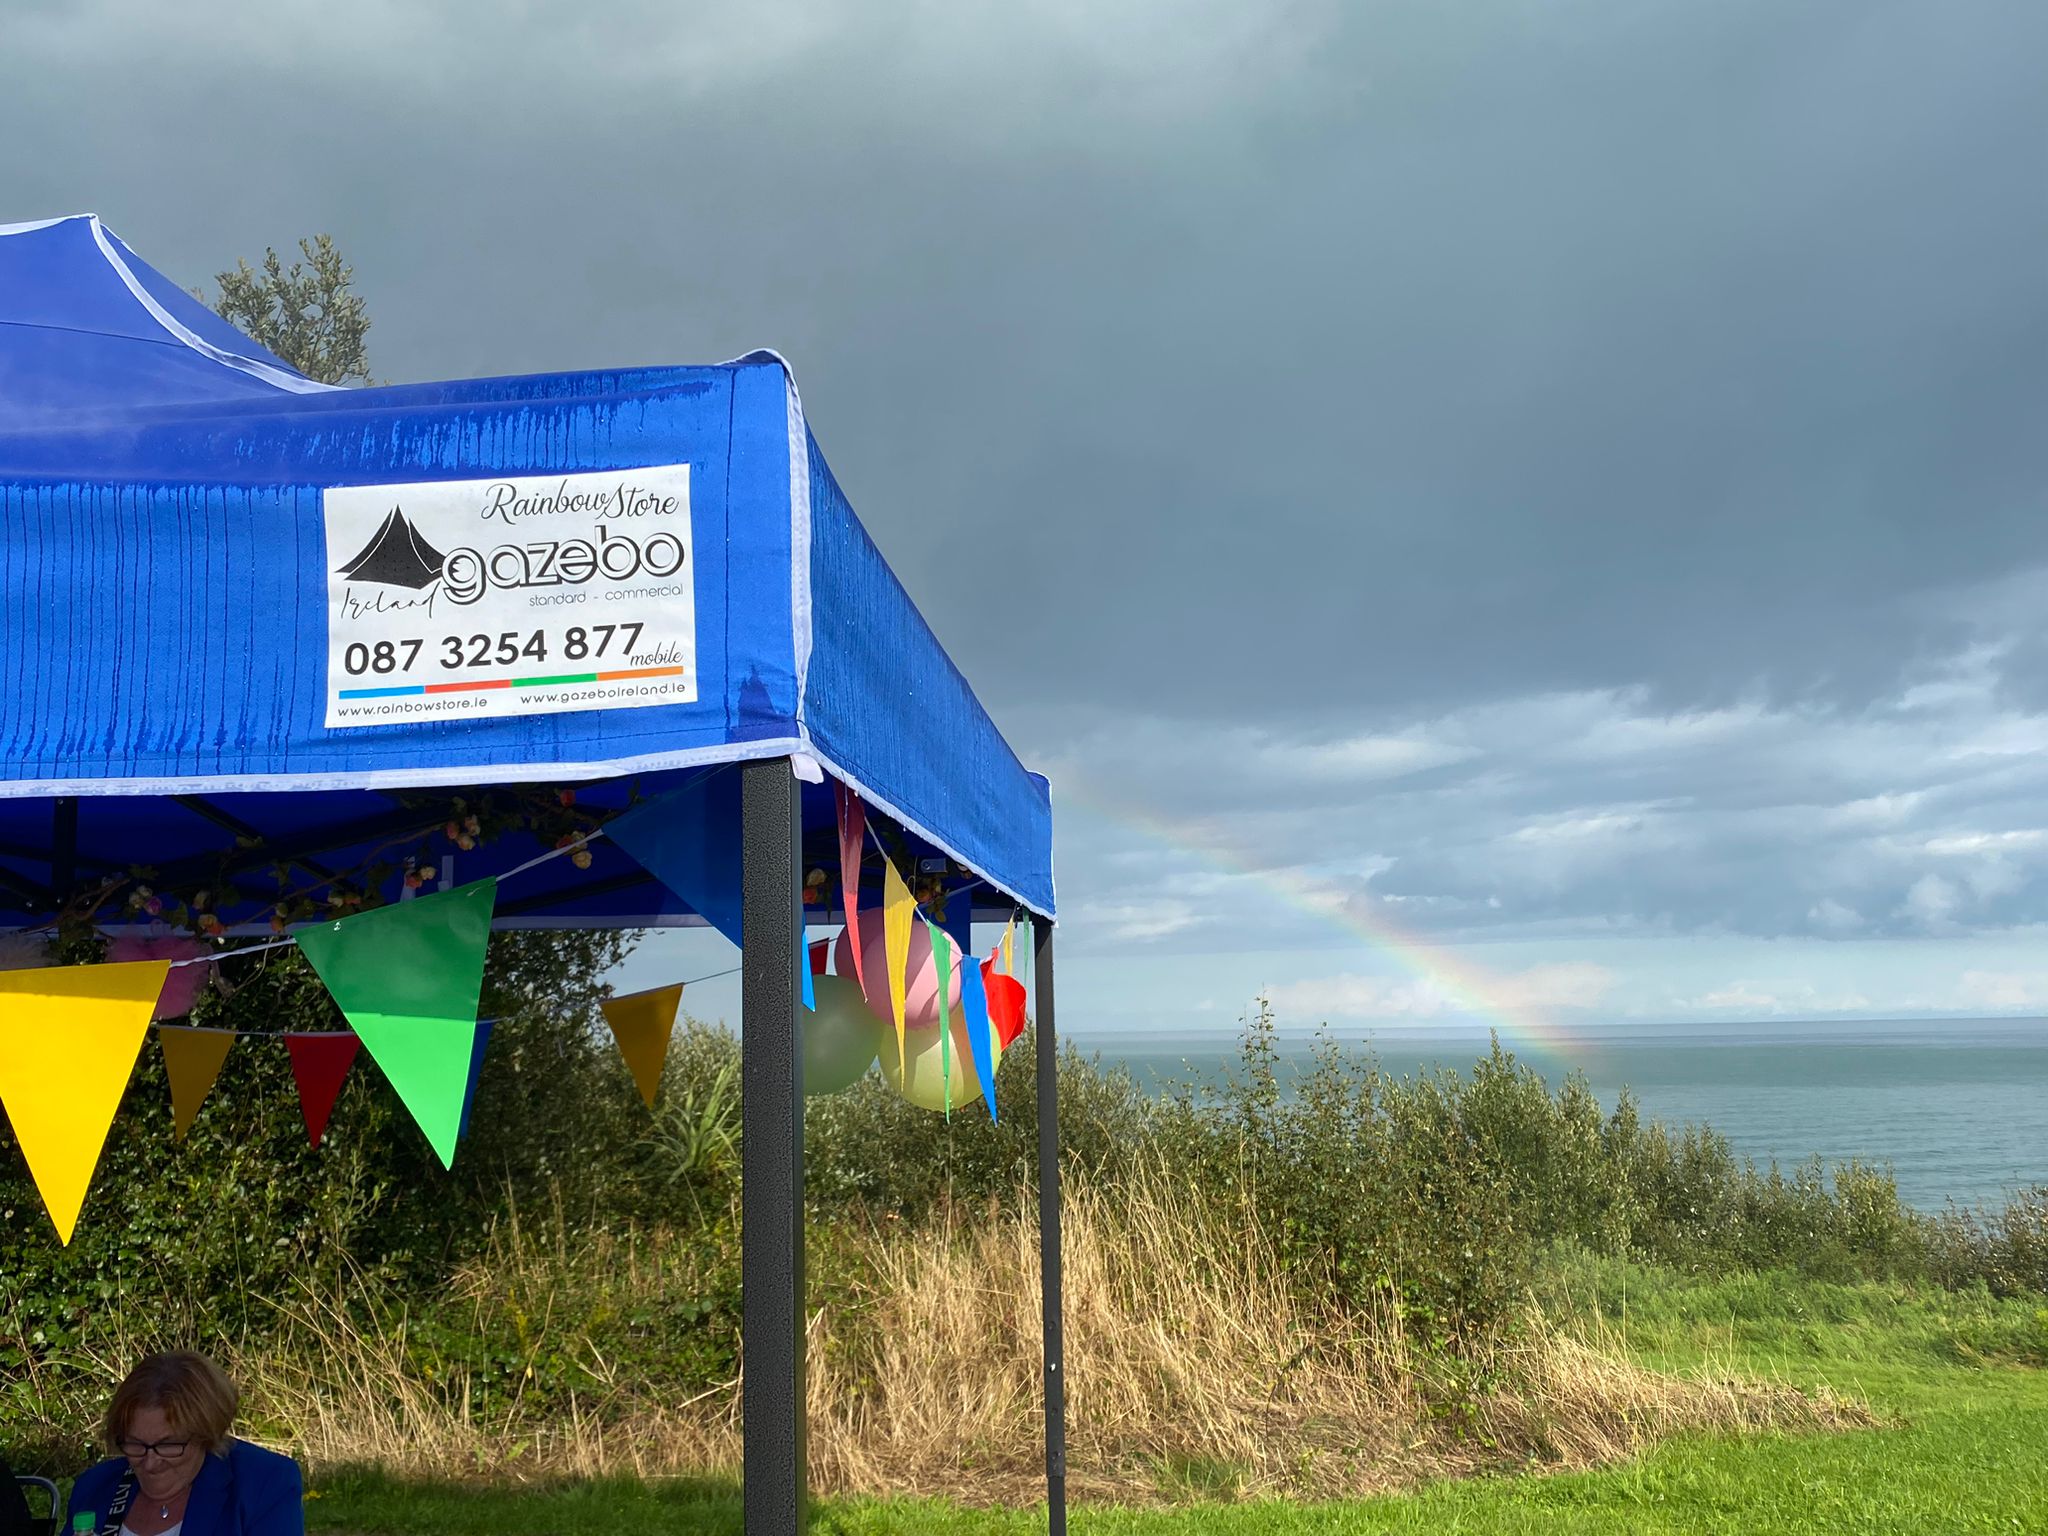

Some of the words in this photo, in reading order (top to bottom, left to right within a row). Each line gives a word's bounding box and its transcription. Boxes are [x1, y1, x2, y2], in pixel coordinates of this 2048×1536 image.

[481, 479, 679, 525] RainbowStore
[441, 525, 684, 605] gazebo
[340, 580, 441, 620] Ireland
[529, 591, 587, 607] standard
[604, 583, 684, 601] commercial
[344, 638, 424, 676] 087
[439, 629, 548, 670] 3254
[564, 622, 644, 660] 877
[630, 641, 683, 666] mobile
[337, 697, 488, 717] www.rainbowstore.ie
[520, 682, 686, 704] www.gazeboireland.ie
